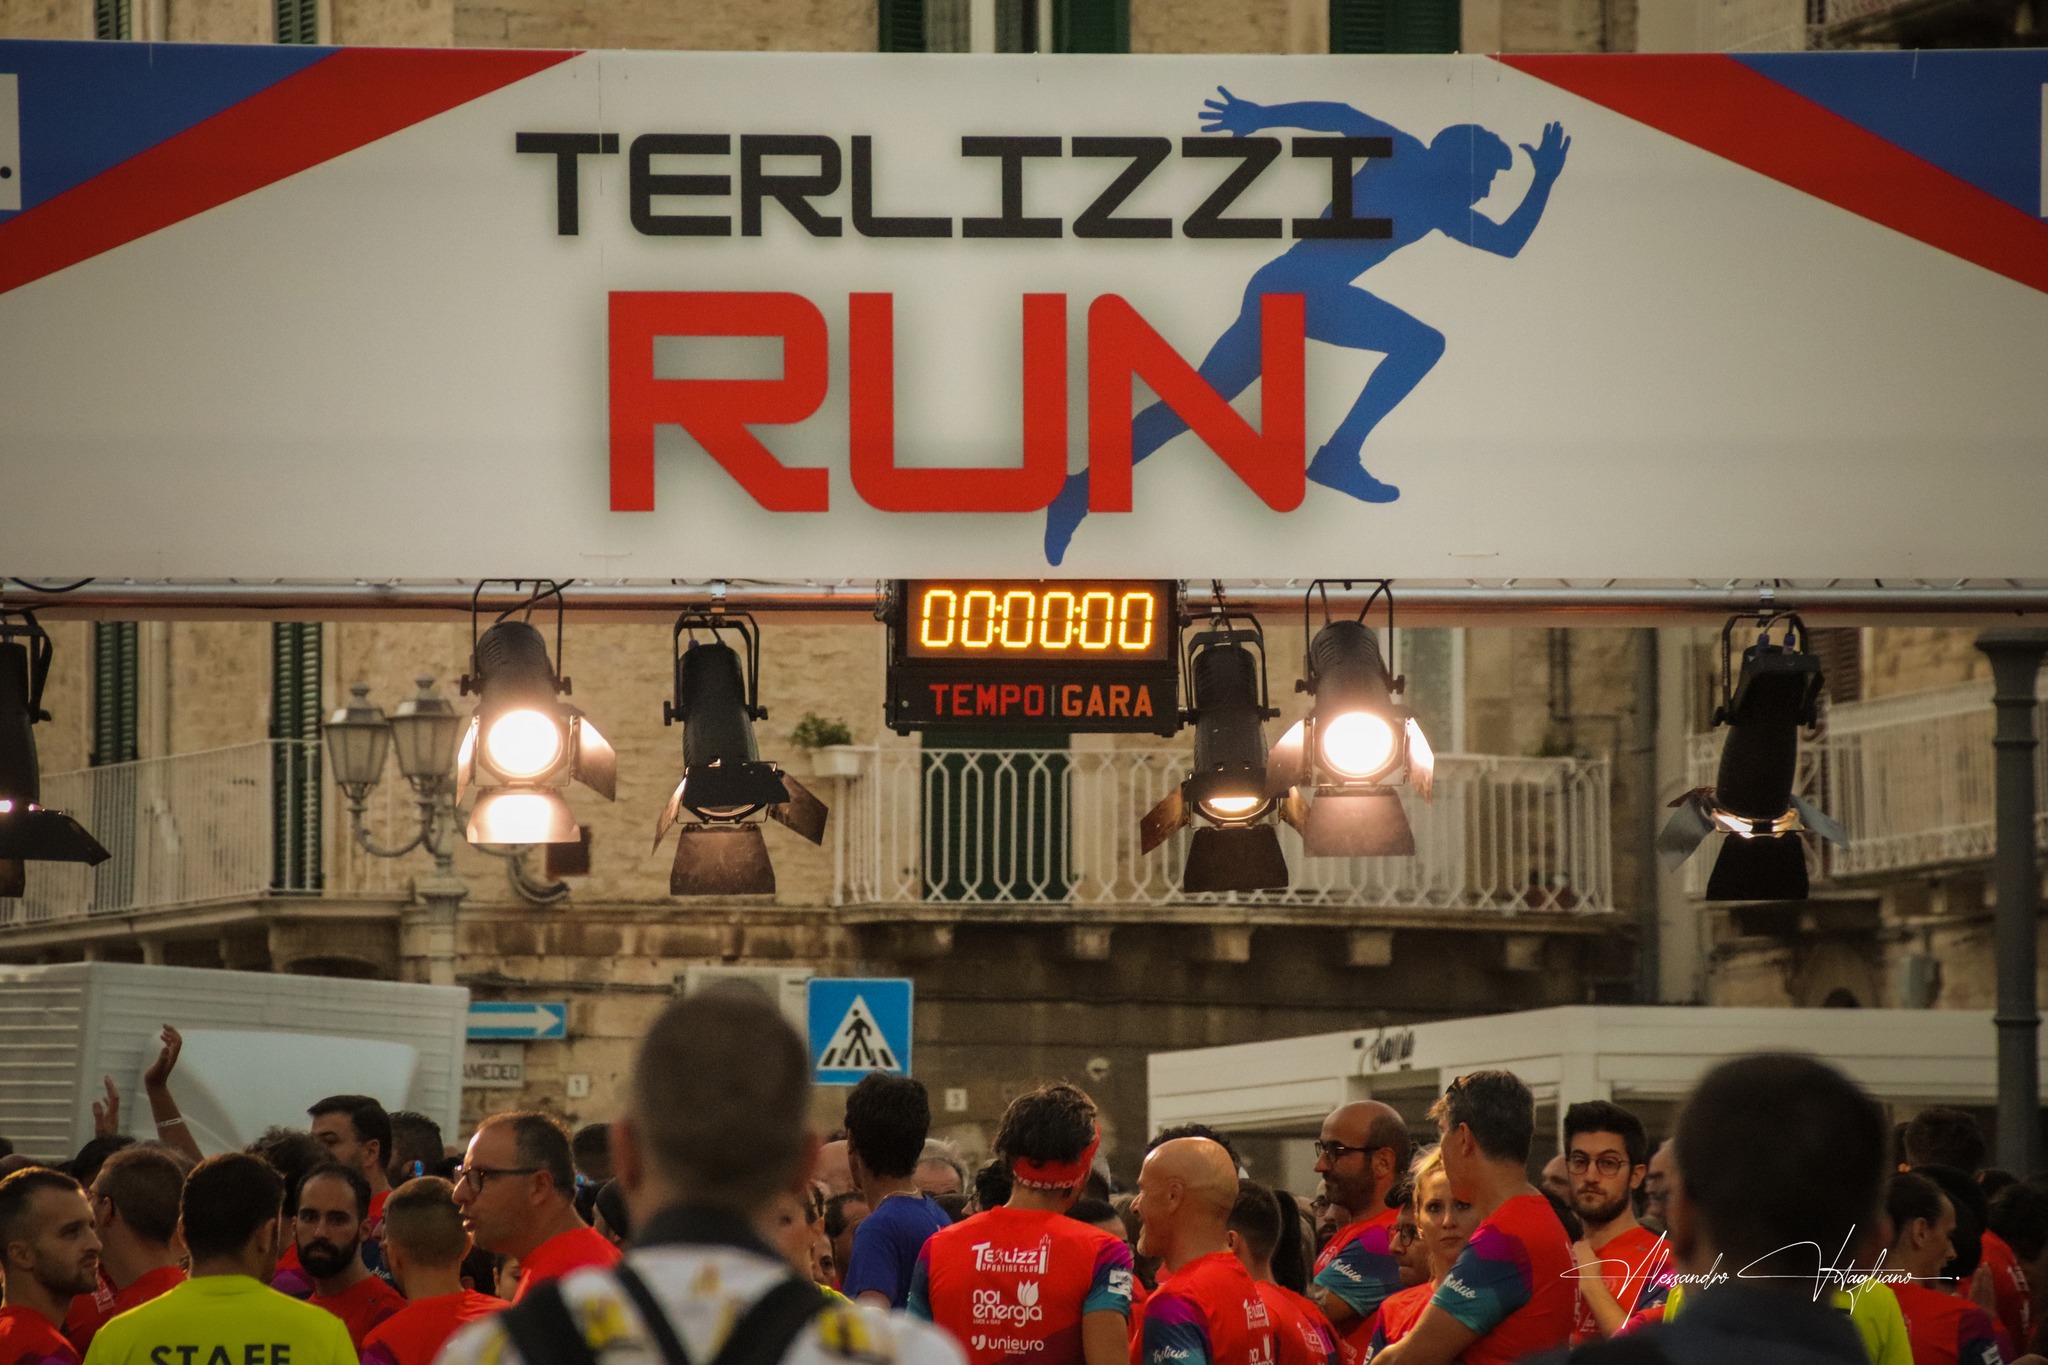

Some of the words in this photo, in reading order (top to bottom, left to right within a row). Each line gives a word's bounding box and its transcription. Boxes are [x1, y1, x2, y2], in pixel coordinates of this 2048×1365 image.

[515, 131, 1393, 239] TERLIZZI
[608, 290, 1307, 513] RUN
[920, 588, 1155, 651] 00:00:00
[928, 684, 1045, 717] TEMPO
[1061, 684, 1154, 718] GARA
[973, 1290, 1000, 1304] noi
[973, 1303, 1043, 1328] energia
[988, 1336, 1045, 1352] unieuro
